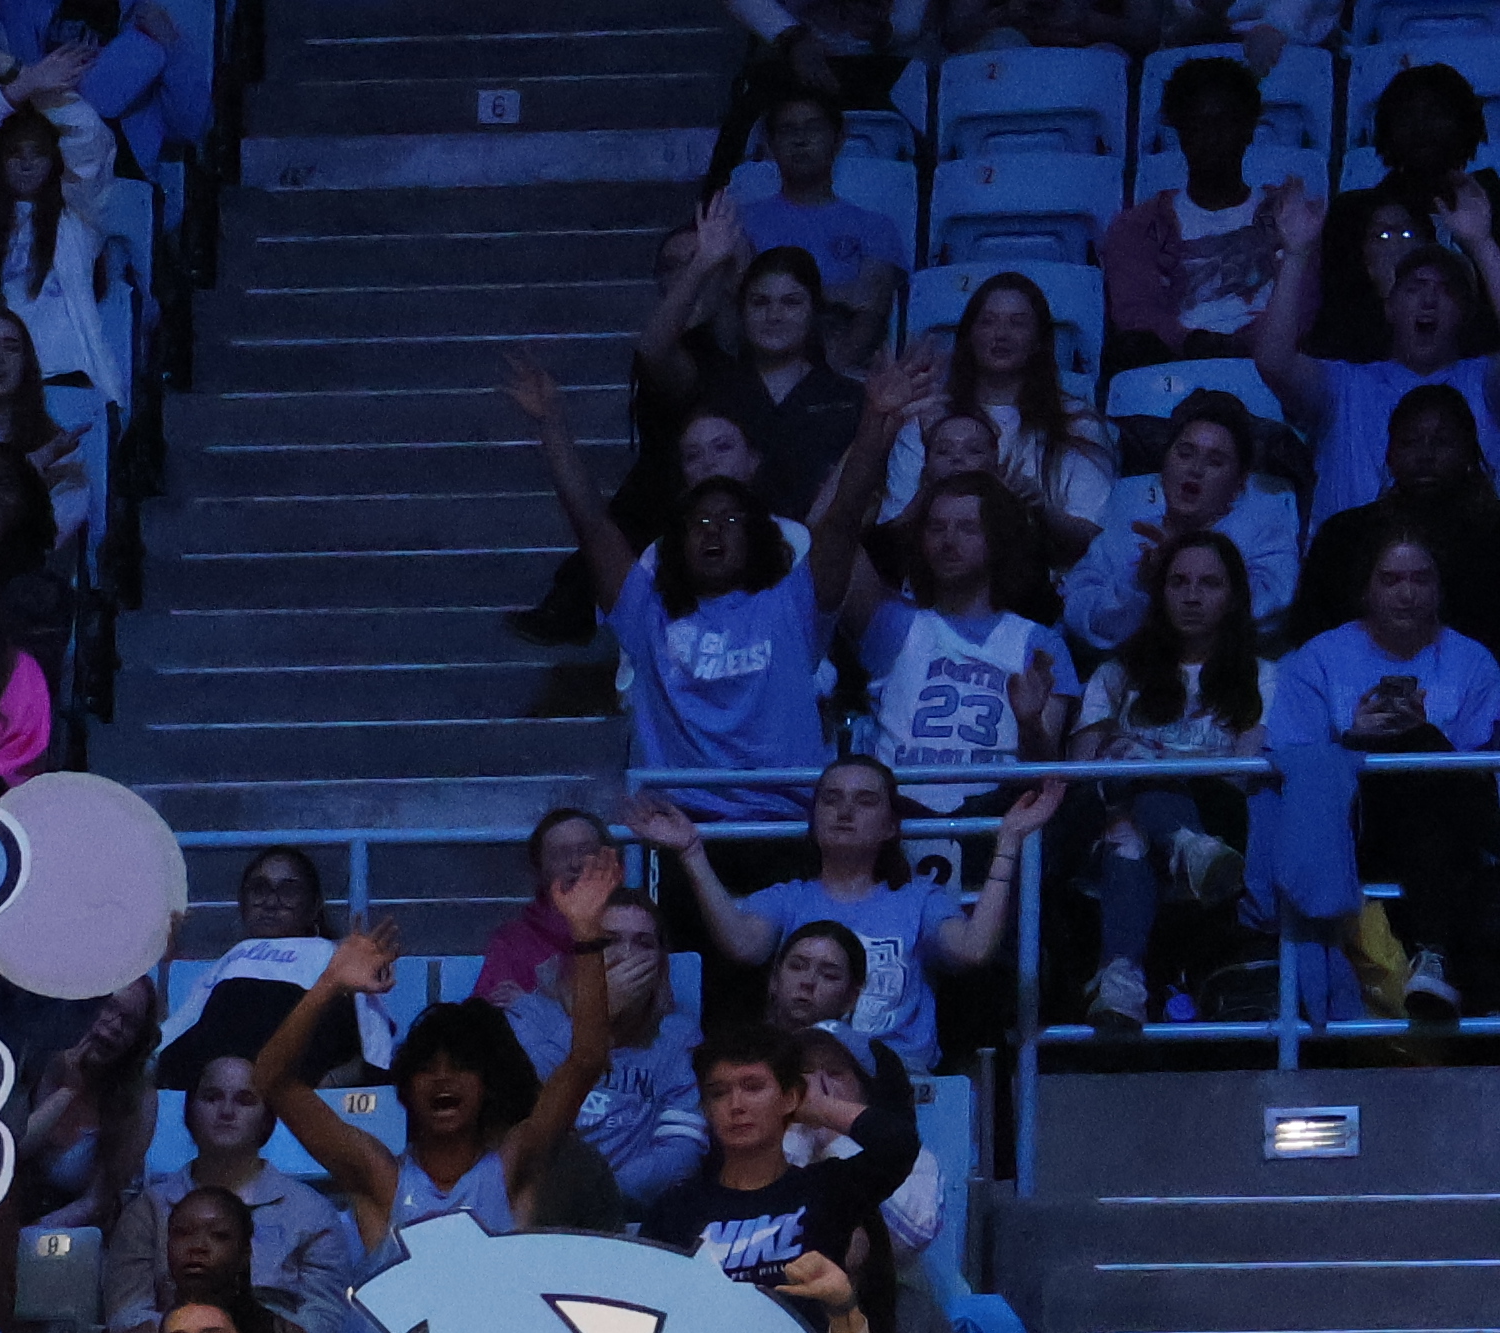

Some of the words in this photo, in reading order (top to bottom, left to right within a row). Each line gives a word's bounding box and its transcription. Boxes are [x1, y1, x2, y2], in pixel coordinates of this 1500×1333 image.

[911, 683, 1004, 748] 23
[347, 1093, 370, 1113] 10
[700, 1205, 806, 1269] NIKE
